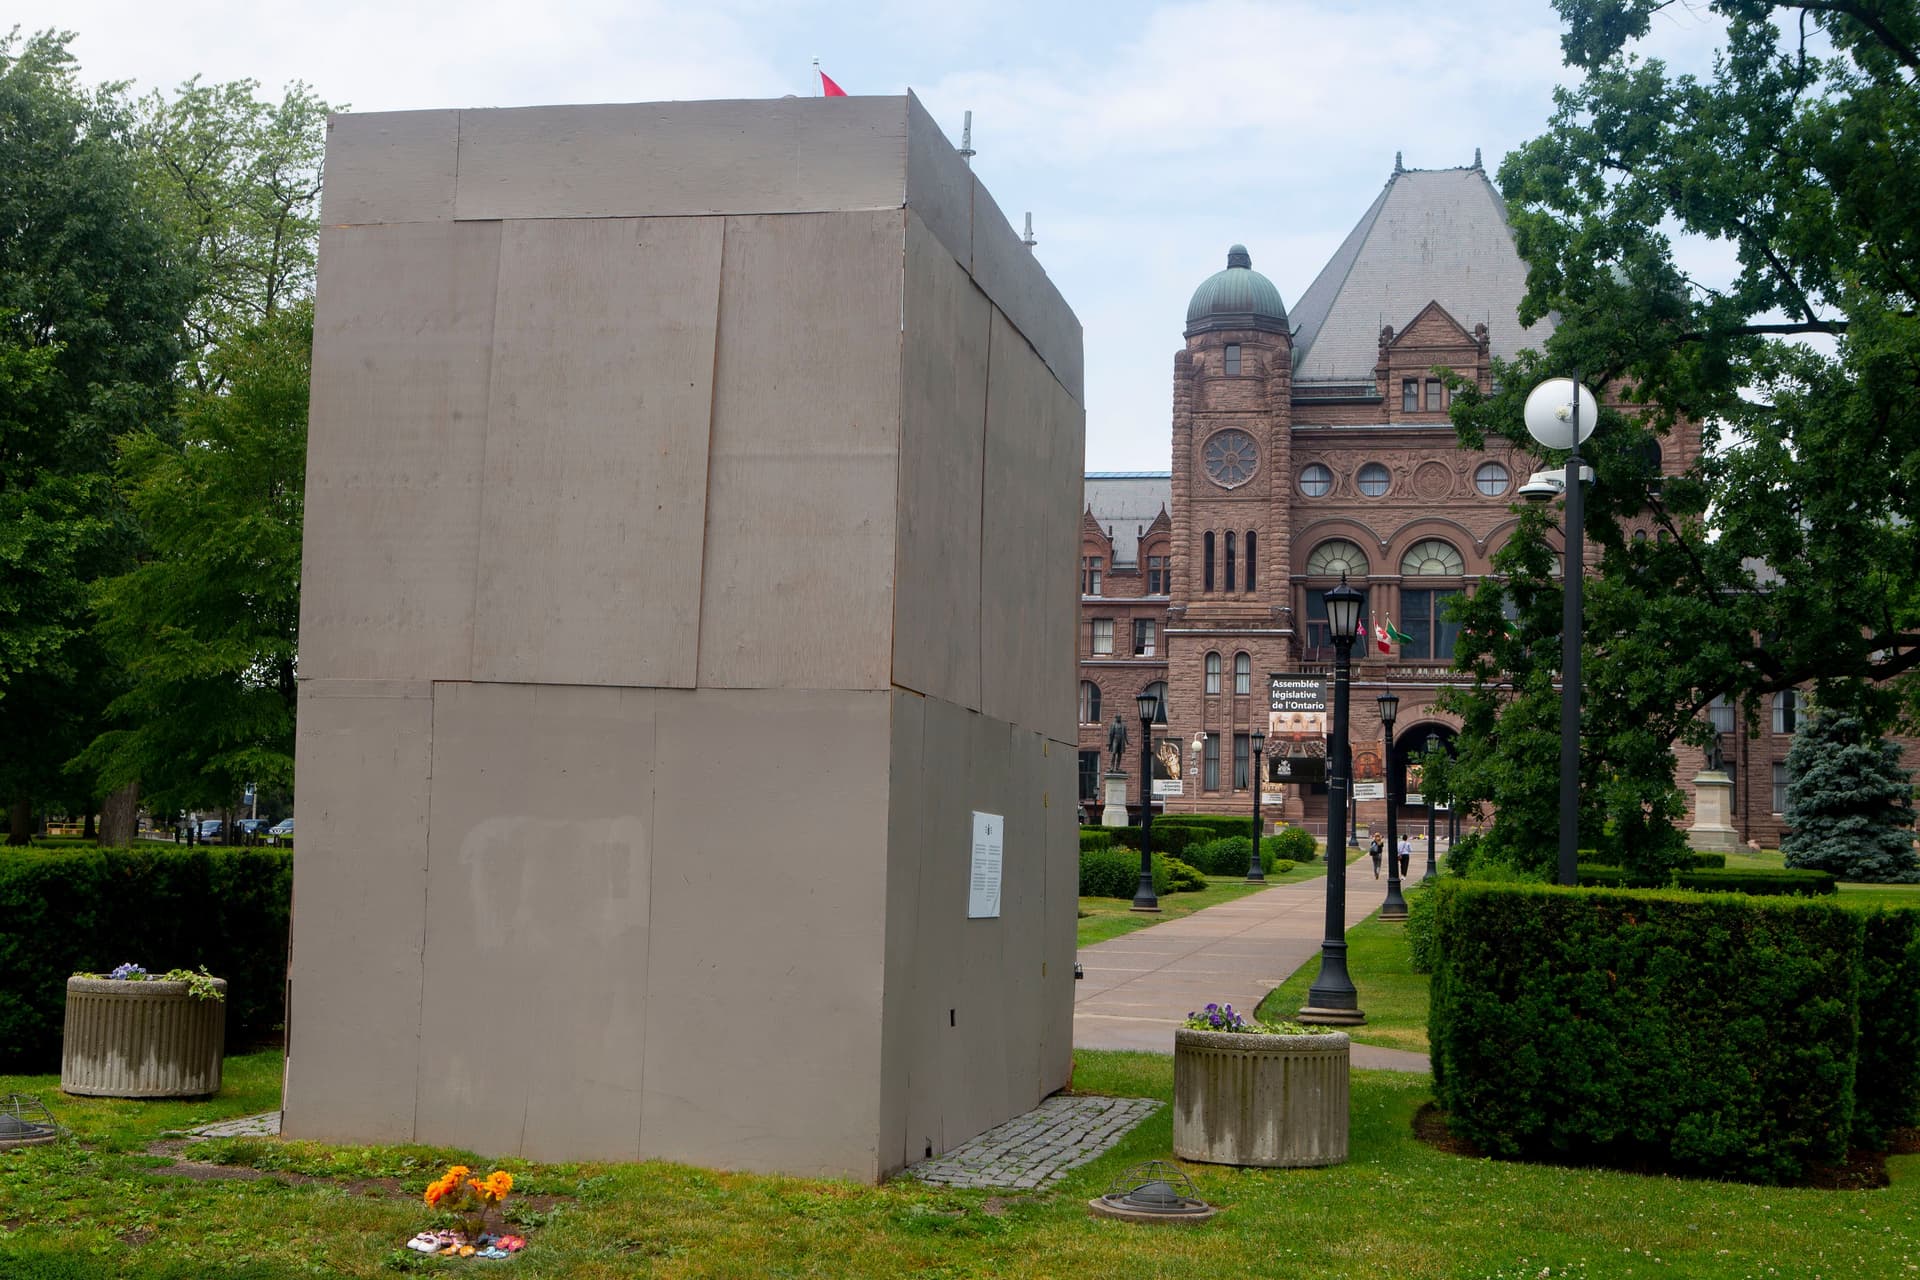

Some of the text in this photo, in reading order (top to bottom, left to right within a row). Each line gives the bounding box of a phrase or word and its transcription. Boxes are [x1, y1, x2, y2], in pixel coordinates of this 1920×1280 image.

[1272, 690, 1317, 700] législative
[1272, 701, 1324, 709] de l'Ontario
